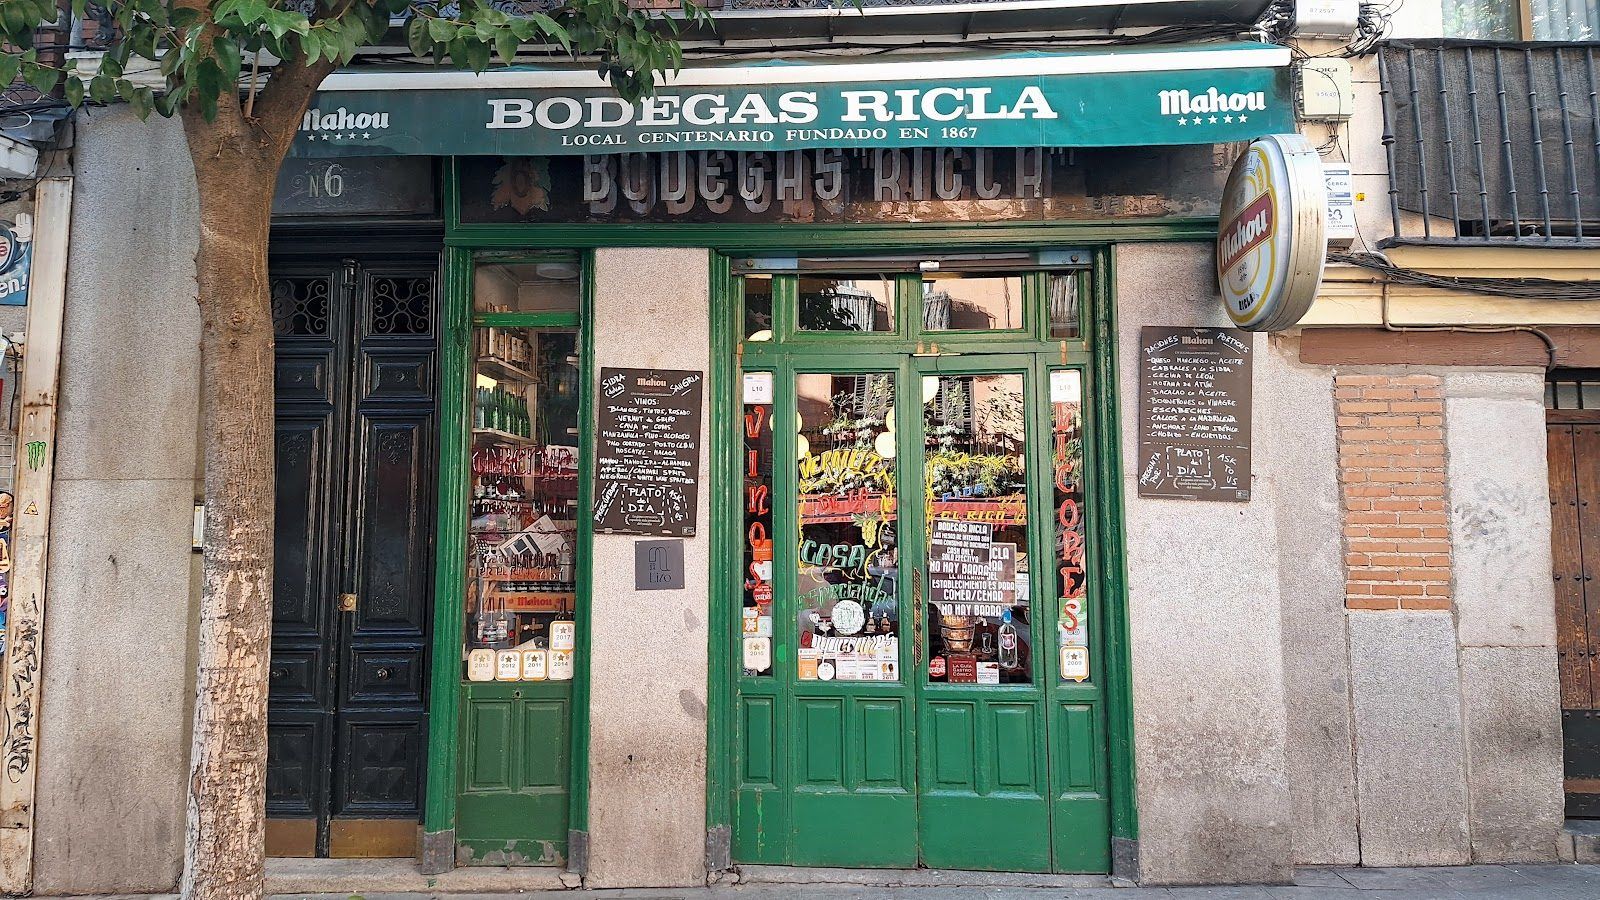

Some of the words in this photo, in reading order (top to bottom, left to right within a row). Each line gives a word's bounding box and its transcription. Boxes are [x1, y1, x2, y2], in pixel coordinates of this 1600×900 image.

[1158, 87, 1267, 115] Mahou
[486, 91, 818, 130] BODEGAS
[841, 86, 1058, 122] RICLA
[561, 134, 627, 146] LOCAL
[638, 130, 774, 144] CENTENARIO
[786, 128, 888, 141] FUNDADO
[899, 127, 929, 139] EN
[941, 127, 978, 139] 1867
[1221, 208, 1268, 267] Mahou
[1144, 334, 1179, 355] RACIONES
[1181, 336, 1213, 345] Mahou
[1150, 357, 1171, 365] QUESO
[602, 373, 626, 390] SIDRA
[637, 378, 667, 387] Mahou
[1151, 388, 1185, 396] BACALAO
[1151, 423, 1186, 431] ANCHOAS
[1174, 447, 1203, 457] PLATO
[1217, 453, 1237, 466] ASK
[1225, 465, 1234, 475] TO
[1226, 476, 1238, 486] US
[627, 488, 662, 498] PLATO
[937, 521, 968, 533] BODEGAS
[969, 523, 988, 535] RICLA
[801, 540, 866, 572] CASA
[947, 546, 960, 554] CASH
[960, 547, 975, 555] ONLY
[941, 553, 954, 561] SOLO
[955, 554, 979, 563] EFECTIVO
[930, 560, 941, 573] NO
[943, 561, 960, 574] HAY
[961, 562, 990, 577] BARRA
[932, 579, 987, 590] ESTABLECIMIENTO
[988, 581, 996, 589] ES
[997, 582, 1015, 591] PARA
[517, 596, 553, 606] Mahou
[943, 590, 1003, 602] COMER/CENAR
[941, 604, 953, 616] NO
[955, 604, 971, 616] HAY
[974, 604, 1002, 617] BARRA
